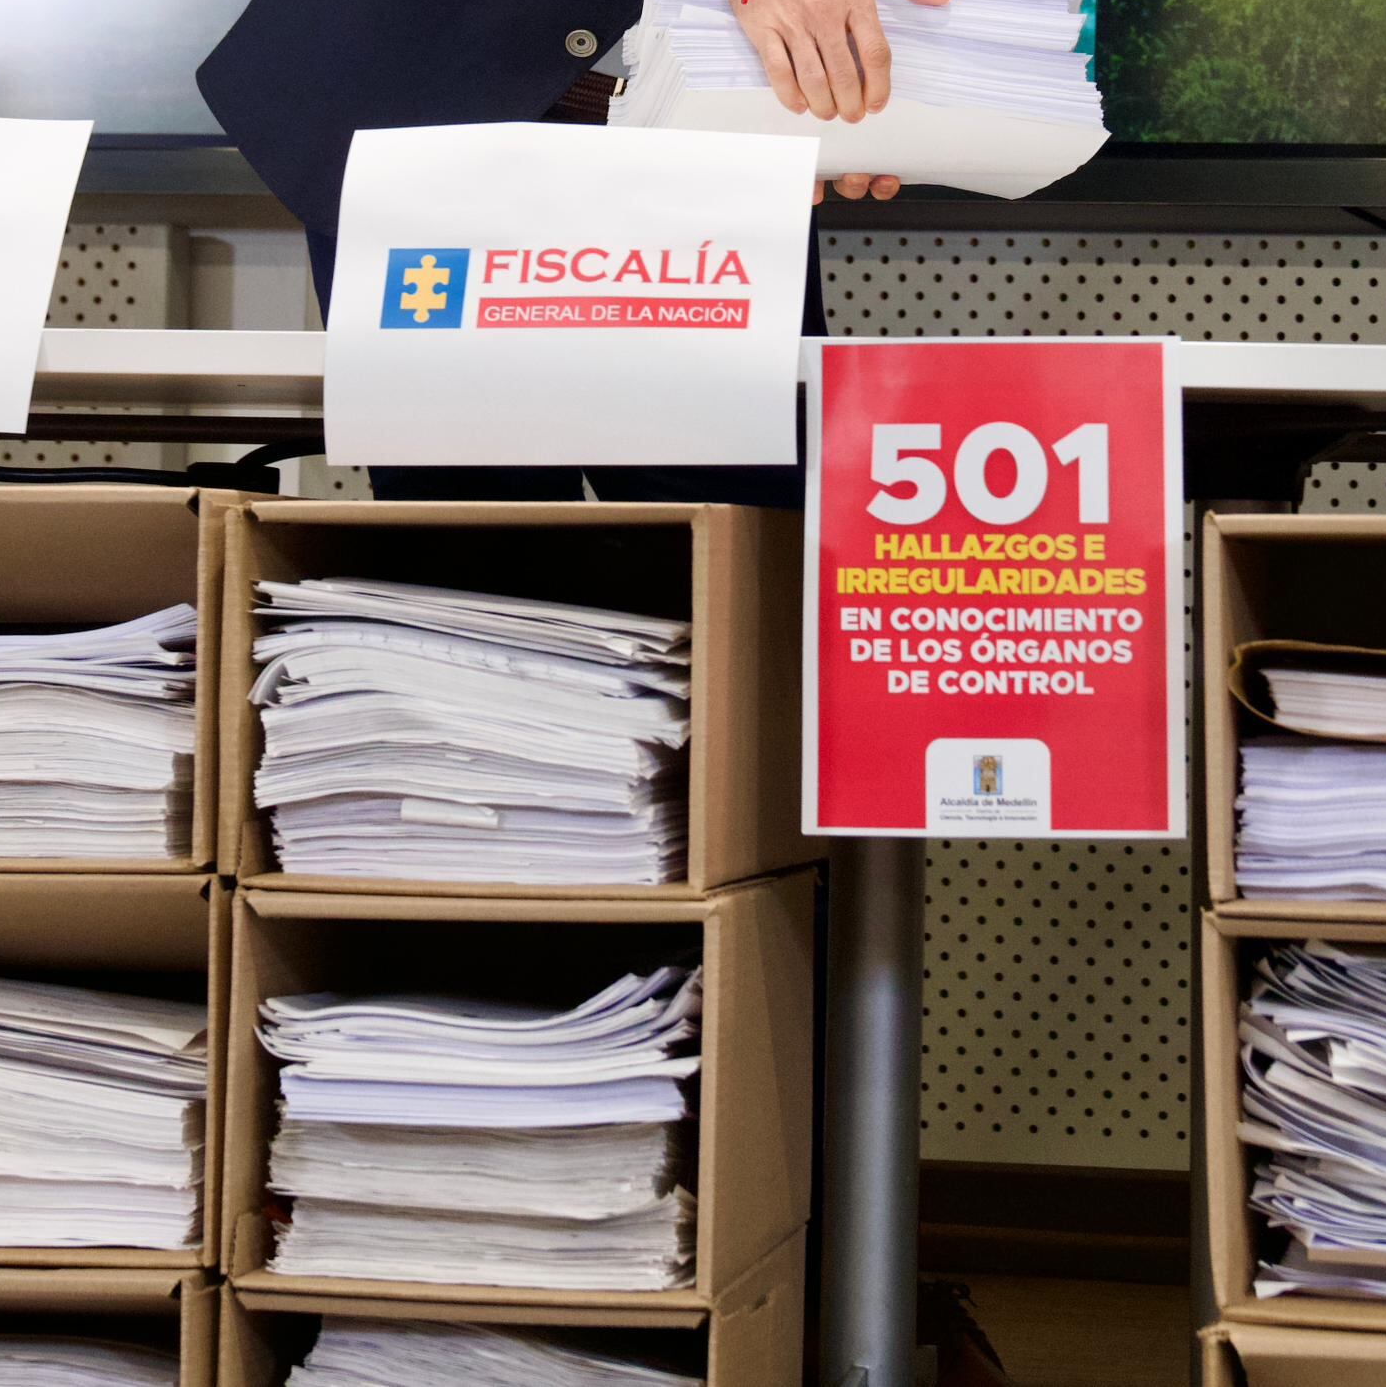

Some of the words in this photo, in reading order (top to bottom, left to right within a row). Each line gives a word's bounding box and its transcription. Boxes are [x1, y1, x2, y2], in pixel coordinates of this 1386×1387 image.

[483, 240, 751, 285] FISCALÍA
[485, 306, 585, 321] GENERAL
[592, 305, 621, 320] DE
[627, 305, 654, 321] LA
[658, 303, 743, 322] NACIÓN
[866, 421, 1109, 525] 501
[875, 534, 1077, 561] HALLAZGOS
[1084, 534, 1105, 560] E
[837, 568, 1147, 595] IRREGULARIDADES
[840, 607, 881, 631] EN
[890, 608, 1143, 632] CONOCIMIENTO
[850, 638, 892, 662] DE
[900, 639, 962, 662] LOS
[970, 633, 1133, 663] ÓRGANOS
[888, 670, 929, 694] DE
[937, 671, 1094, 695] CONTROL
